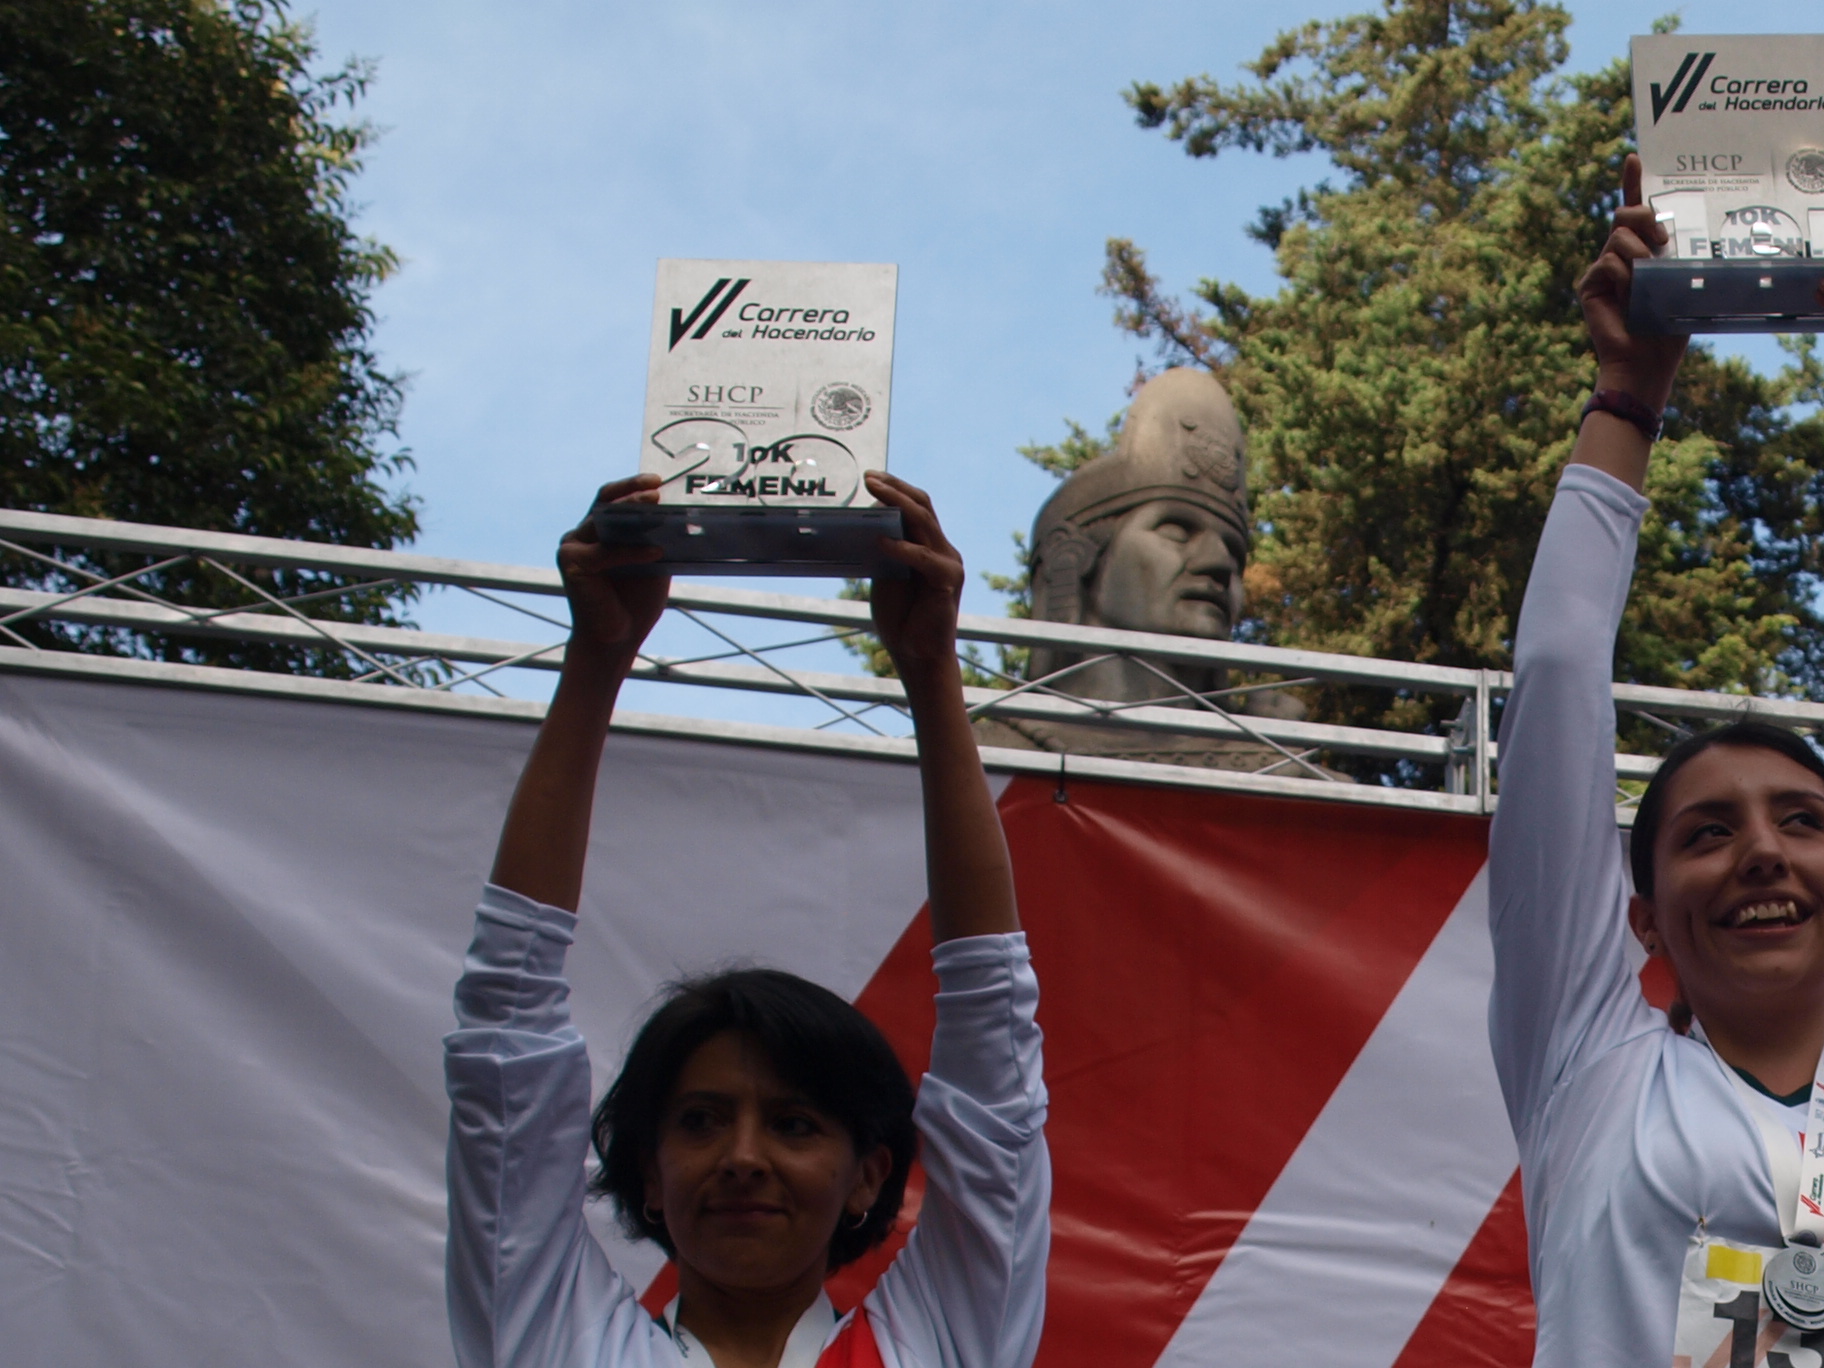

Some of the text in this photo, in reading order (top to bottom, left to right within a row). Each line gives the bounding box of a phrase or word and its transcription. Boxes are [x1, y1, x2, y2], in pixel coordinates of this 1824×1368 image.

[1710, 75, 1808, 95] Carrera
[1698, 101, 1717, 111] del
[1676, 154, 1743, 172] SHCP
[738, 302, 850, 324] Carrera
[722, 324, 876, 342] del Hacendario
[687, 385, 764, 404] SHCP
